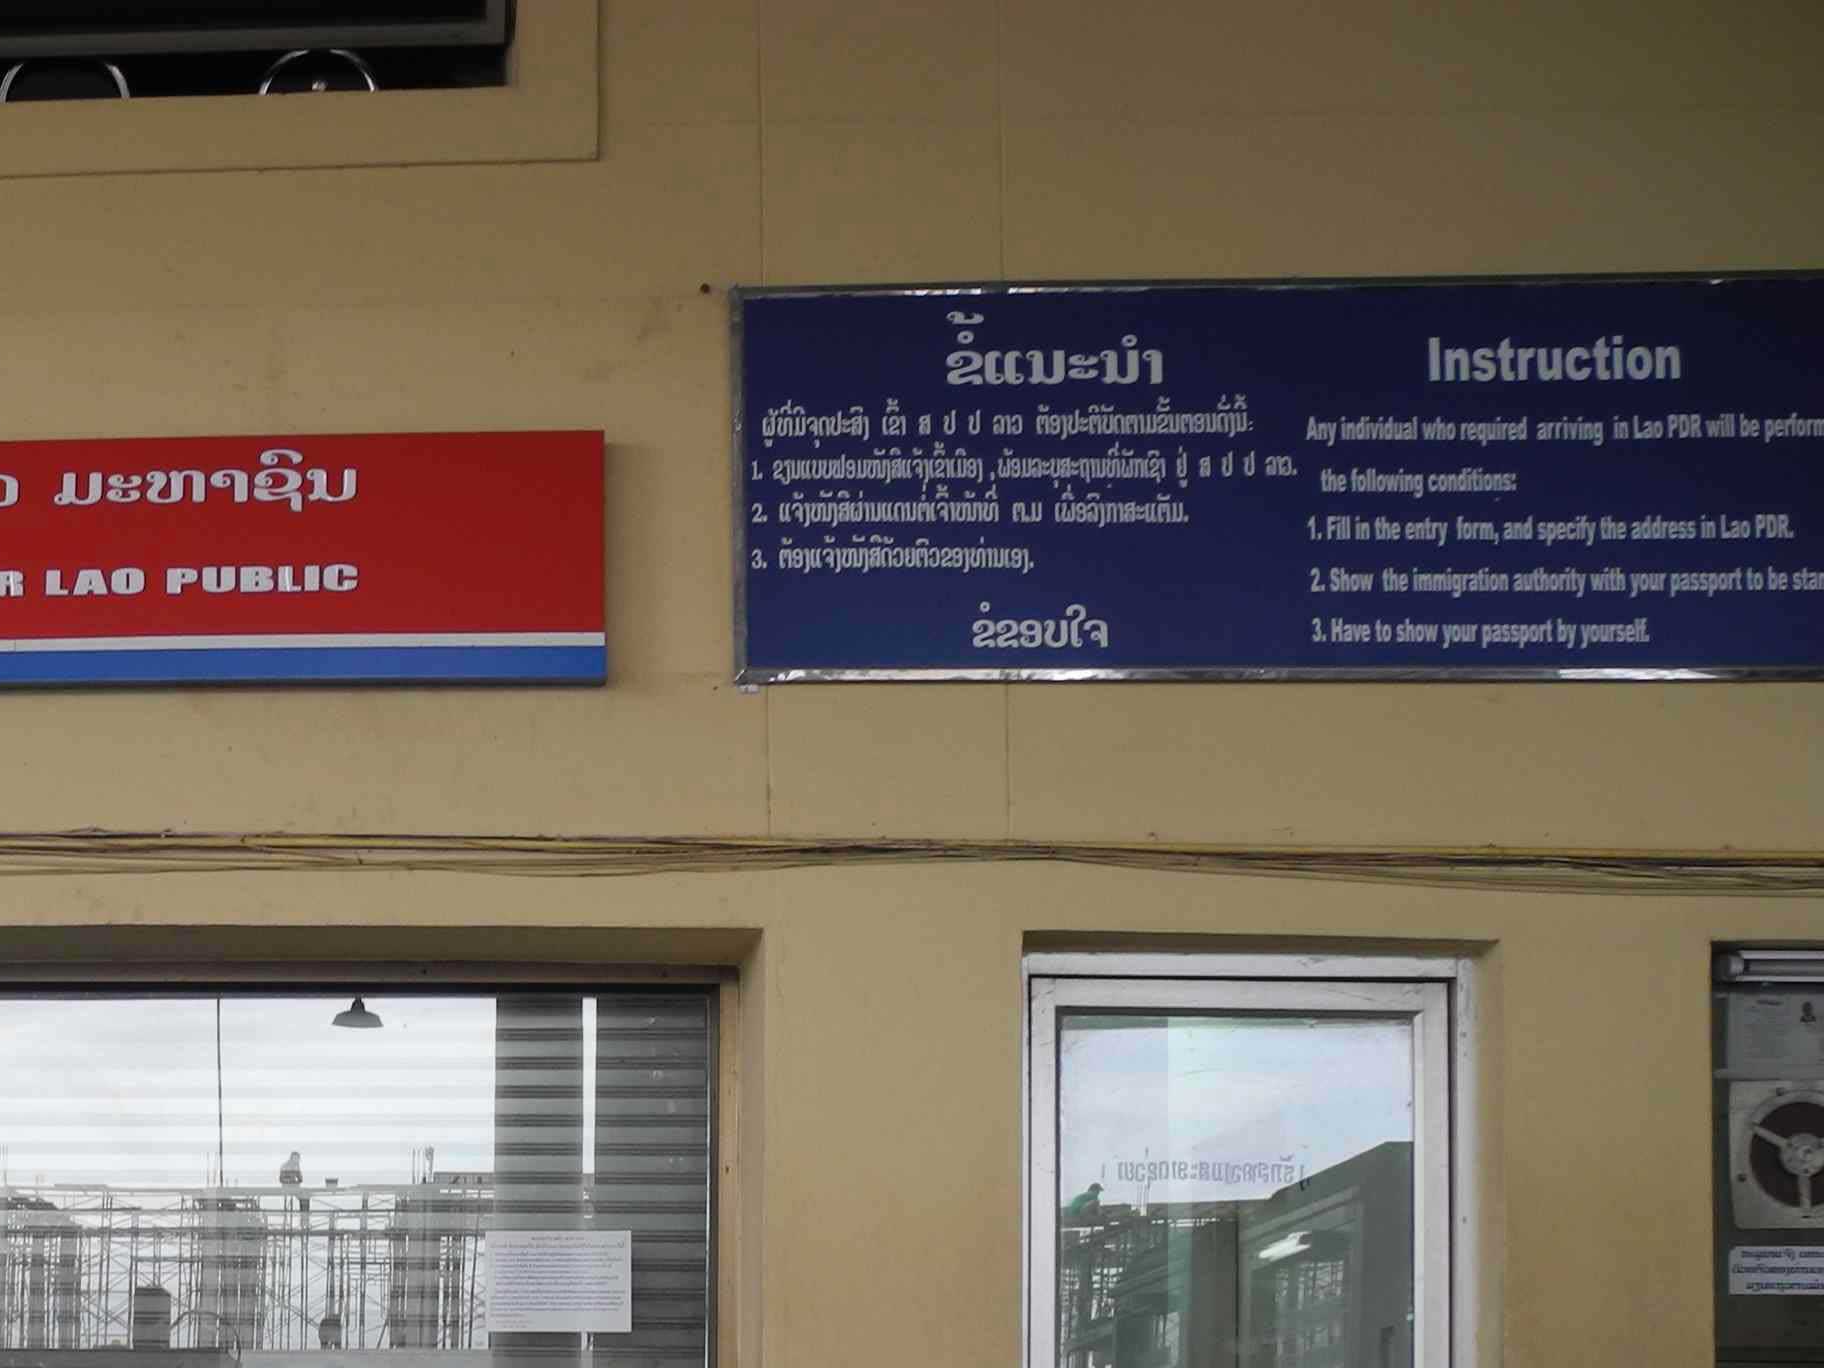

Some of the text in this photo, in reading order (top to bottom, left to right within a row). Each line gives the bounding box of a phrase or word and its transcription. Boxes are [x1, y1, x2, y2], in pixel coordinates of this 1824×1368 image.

[1428, 335, 1681, 382] Instruction
[1306, 416, 1337, 446] Any
[1340, 416, 1418, 441] individual
[1422, 416, 1456, 440] who
[1460, 417, 1527, 447] required
[1536, 417, 1604, 446] arriving
[1614, 416, 1628, 439] in
[1633, 416, 1663, 439] Lao
[1667, 414, 1702, 438] PDR
[1705, 414, 1735, 437] will
[1740, 414, 1760, 437] be
[752, 460, 763, 480] 1.
[1321, 468, 1517, 497] the following conditions:
[752, 503, 768, 523] 2.
[1308, 514, 1794, 546] 1. Fill in the entry form, and specify the address in Lao PDR.
[752, 548, 768, 569] 3.
[45, 568, 145, 595] LAO
[166, 564, 359, 595] PUBLIC
[1310, 568, 1325, 592] 2.
[1330, 568, 1373, 593] Show
[1382, 567, 1408, 592] the
[1412, 568, 1509, 597] immigration
[1513, 567, 1586, 597] authority
[1590, 567, 1626, 593] with
[1630, 570, 1666, 597] your
[1669, 568, 1742, 597] passport
[1746, 567, 1764, 591] to
[1768, 566, 1788, 591] be
[1312, 617, 1650, 648] 3. Have to show your passport by yourself.
